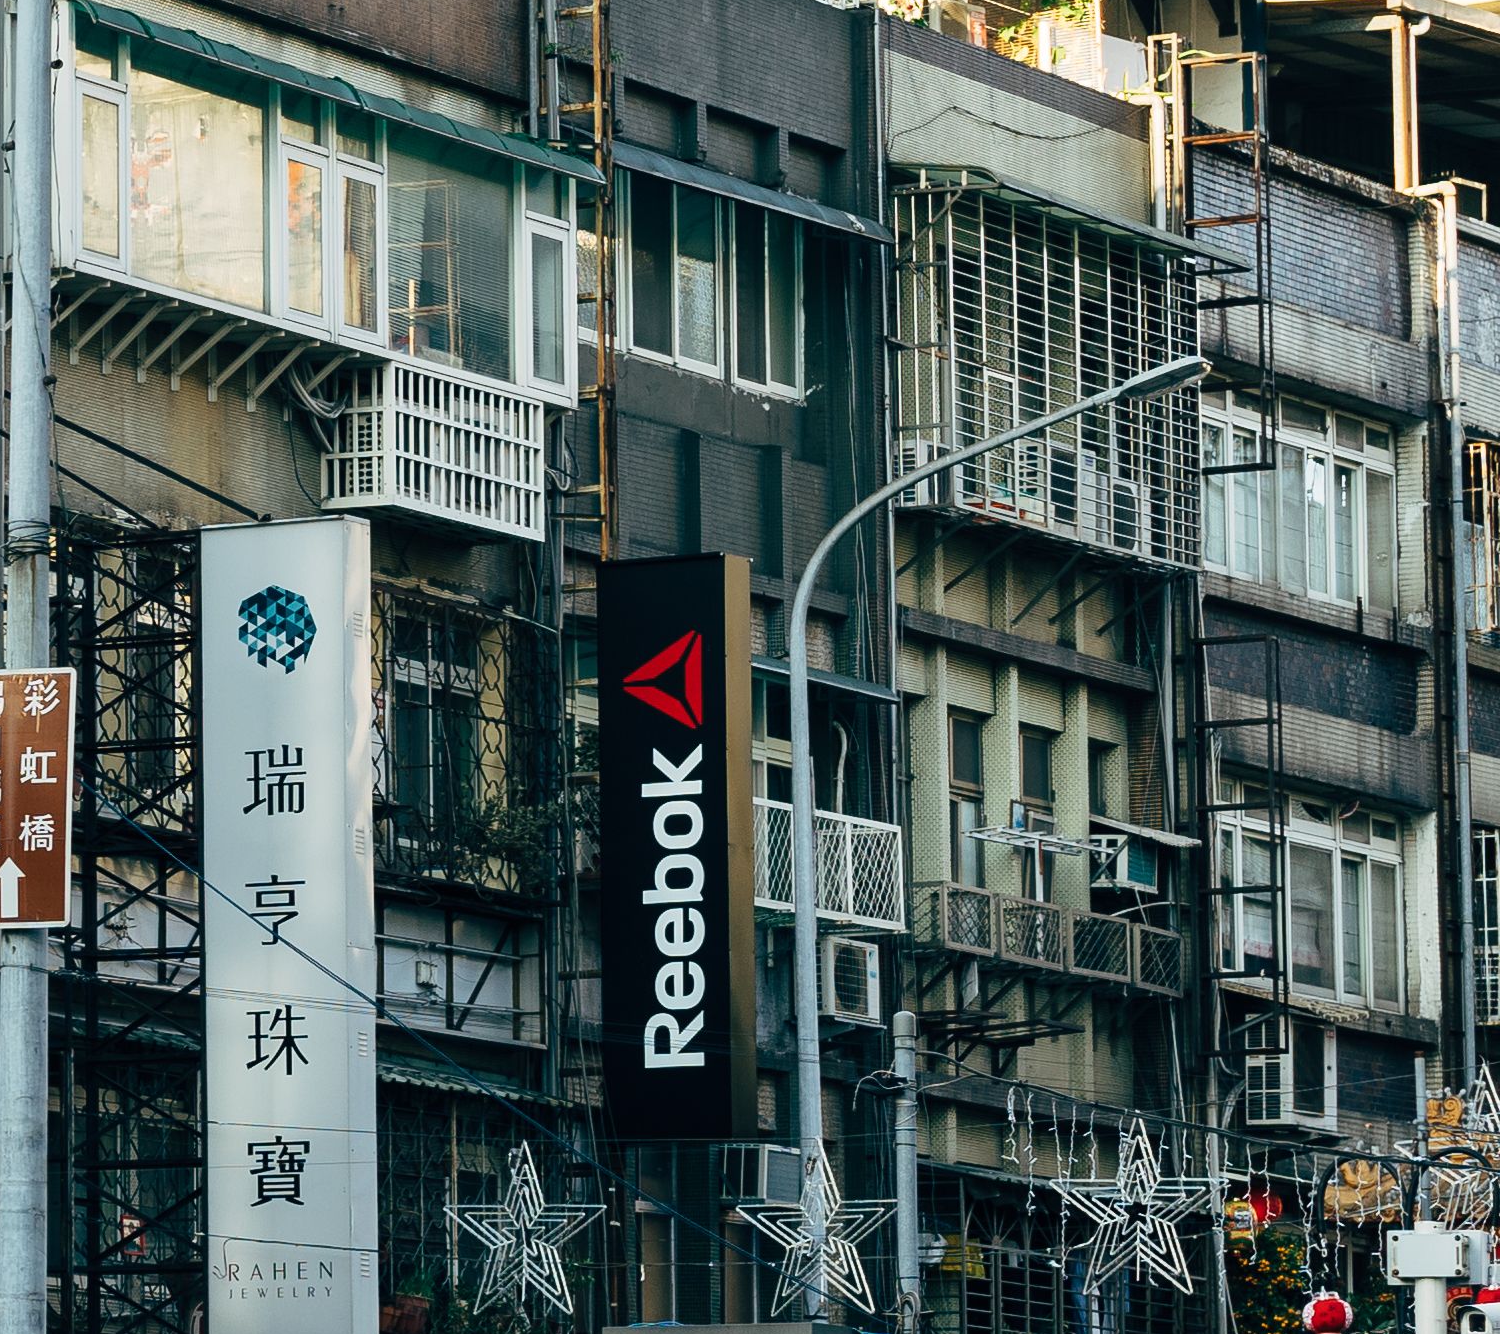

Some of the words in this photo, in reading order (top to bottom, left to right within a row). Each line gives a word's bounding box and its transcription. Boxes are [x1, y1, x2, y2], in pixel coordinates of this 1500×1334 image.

[19, 678, 61, 853] 彩虹橋
[242, 742, 312, 1209] 瑞亨珠寶
[640, 742, 706, 1070] Reebok
[227, 1260, 335, 1283] RAHEN
[227, 1286, 334, 1300] JEWELRY
